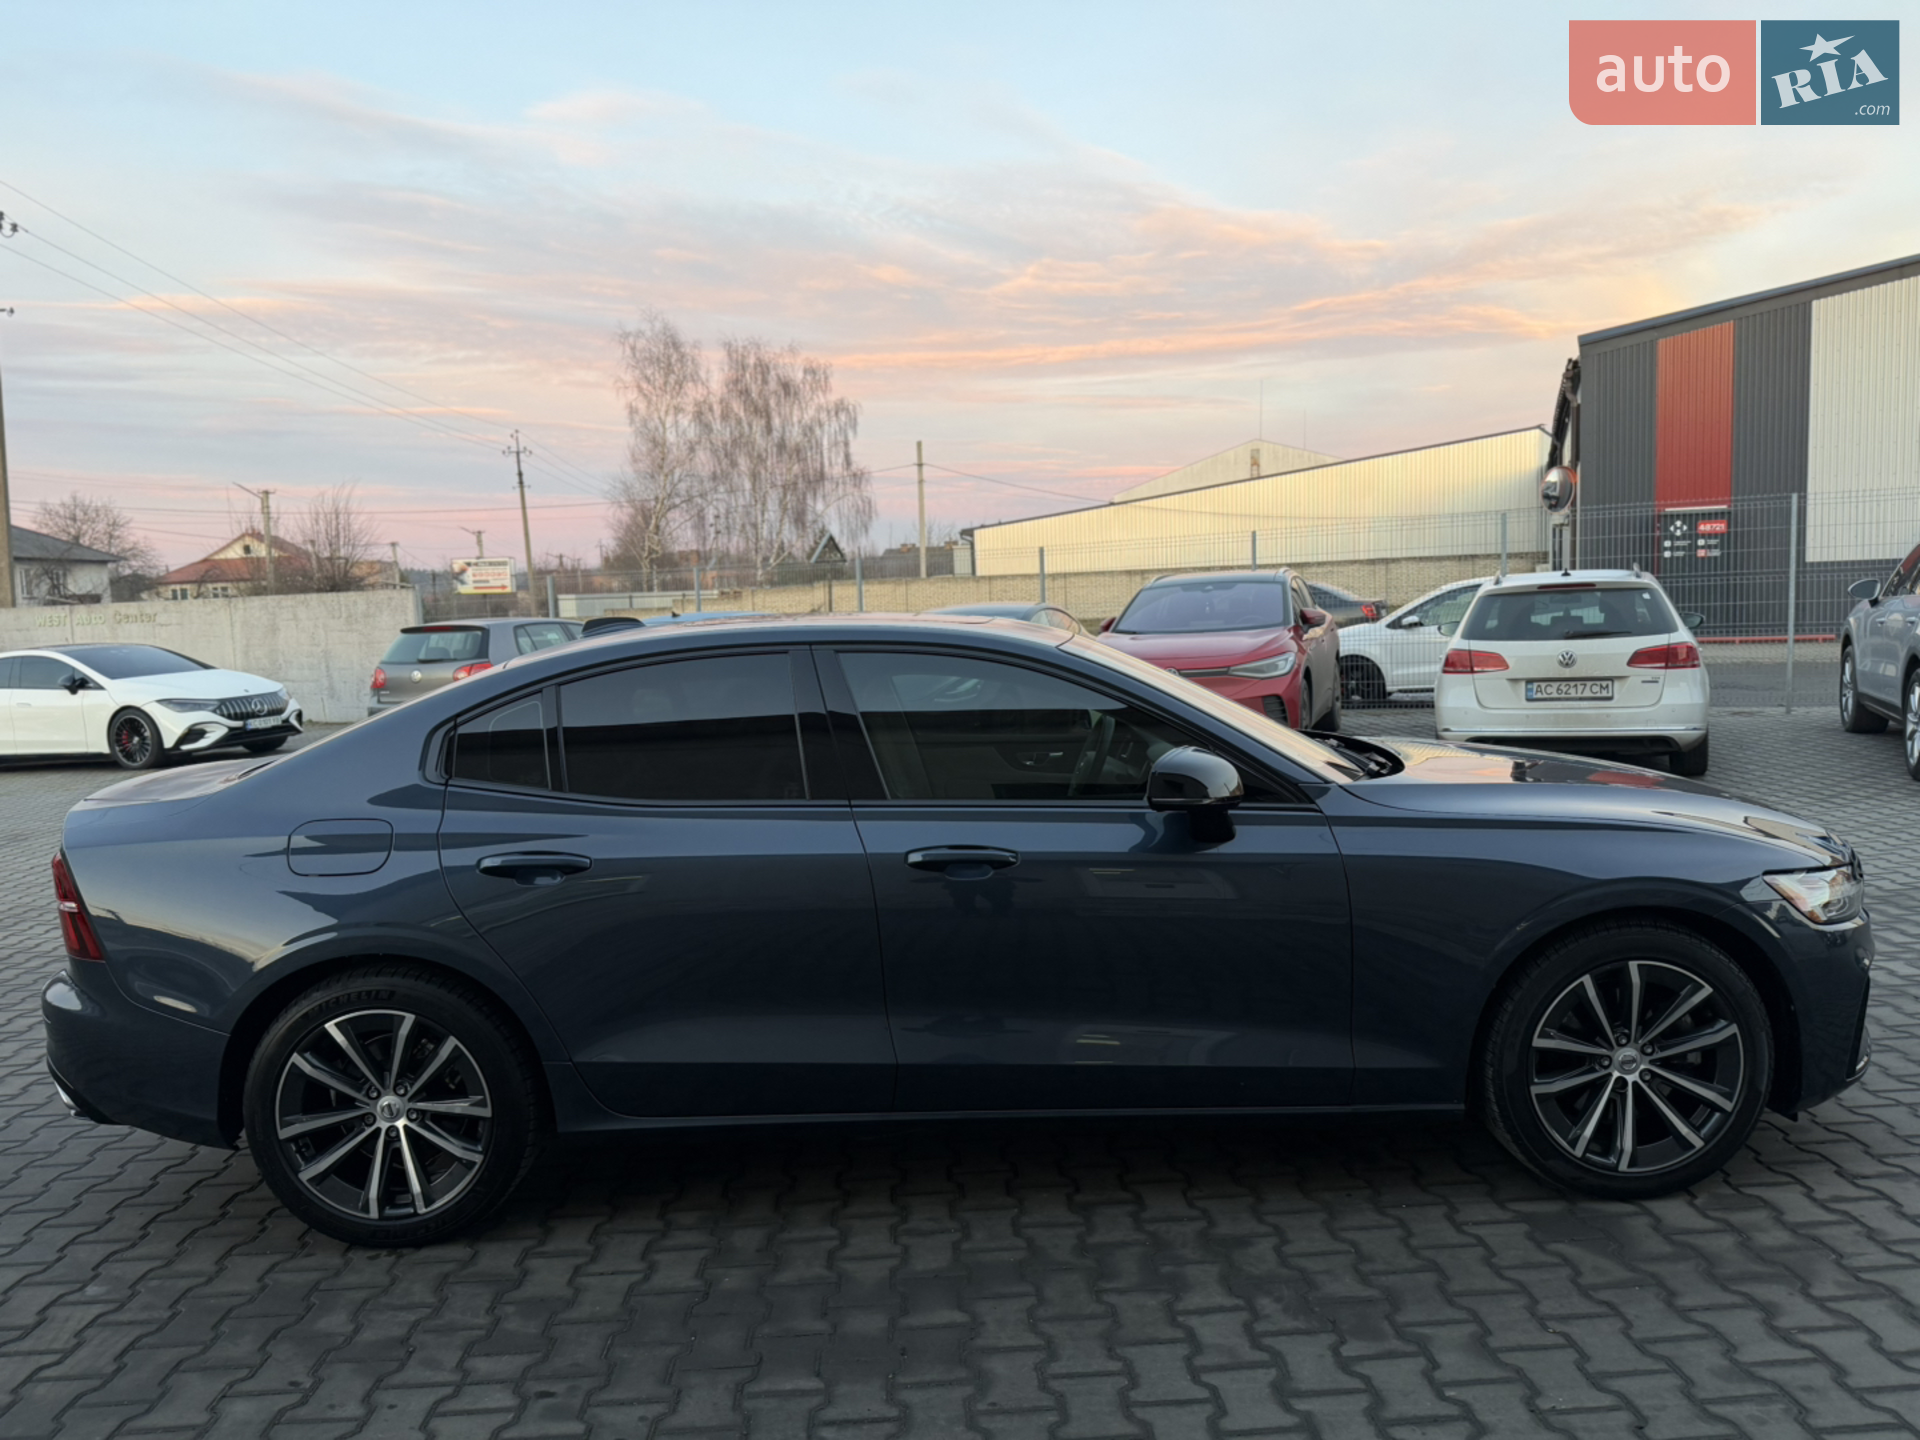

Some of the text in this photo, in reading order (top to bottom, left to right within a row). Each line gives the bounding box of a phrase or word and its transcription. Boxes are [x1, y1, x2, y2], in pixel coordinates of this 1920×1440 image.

[36, 611, 158, 628] WEST Auto Center
[1534, 683, 1610, 696] AC 6217 CM
[308, 990, 391, 1018] MICHELIN
